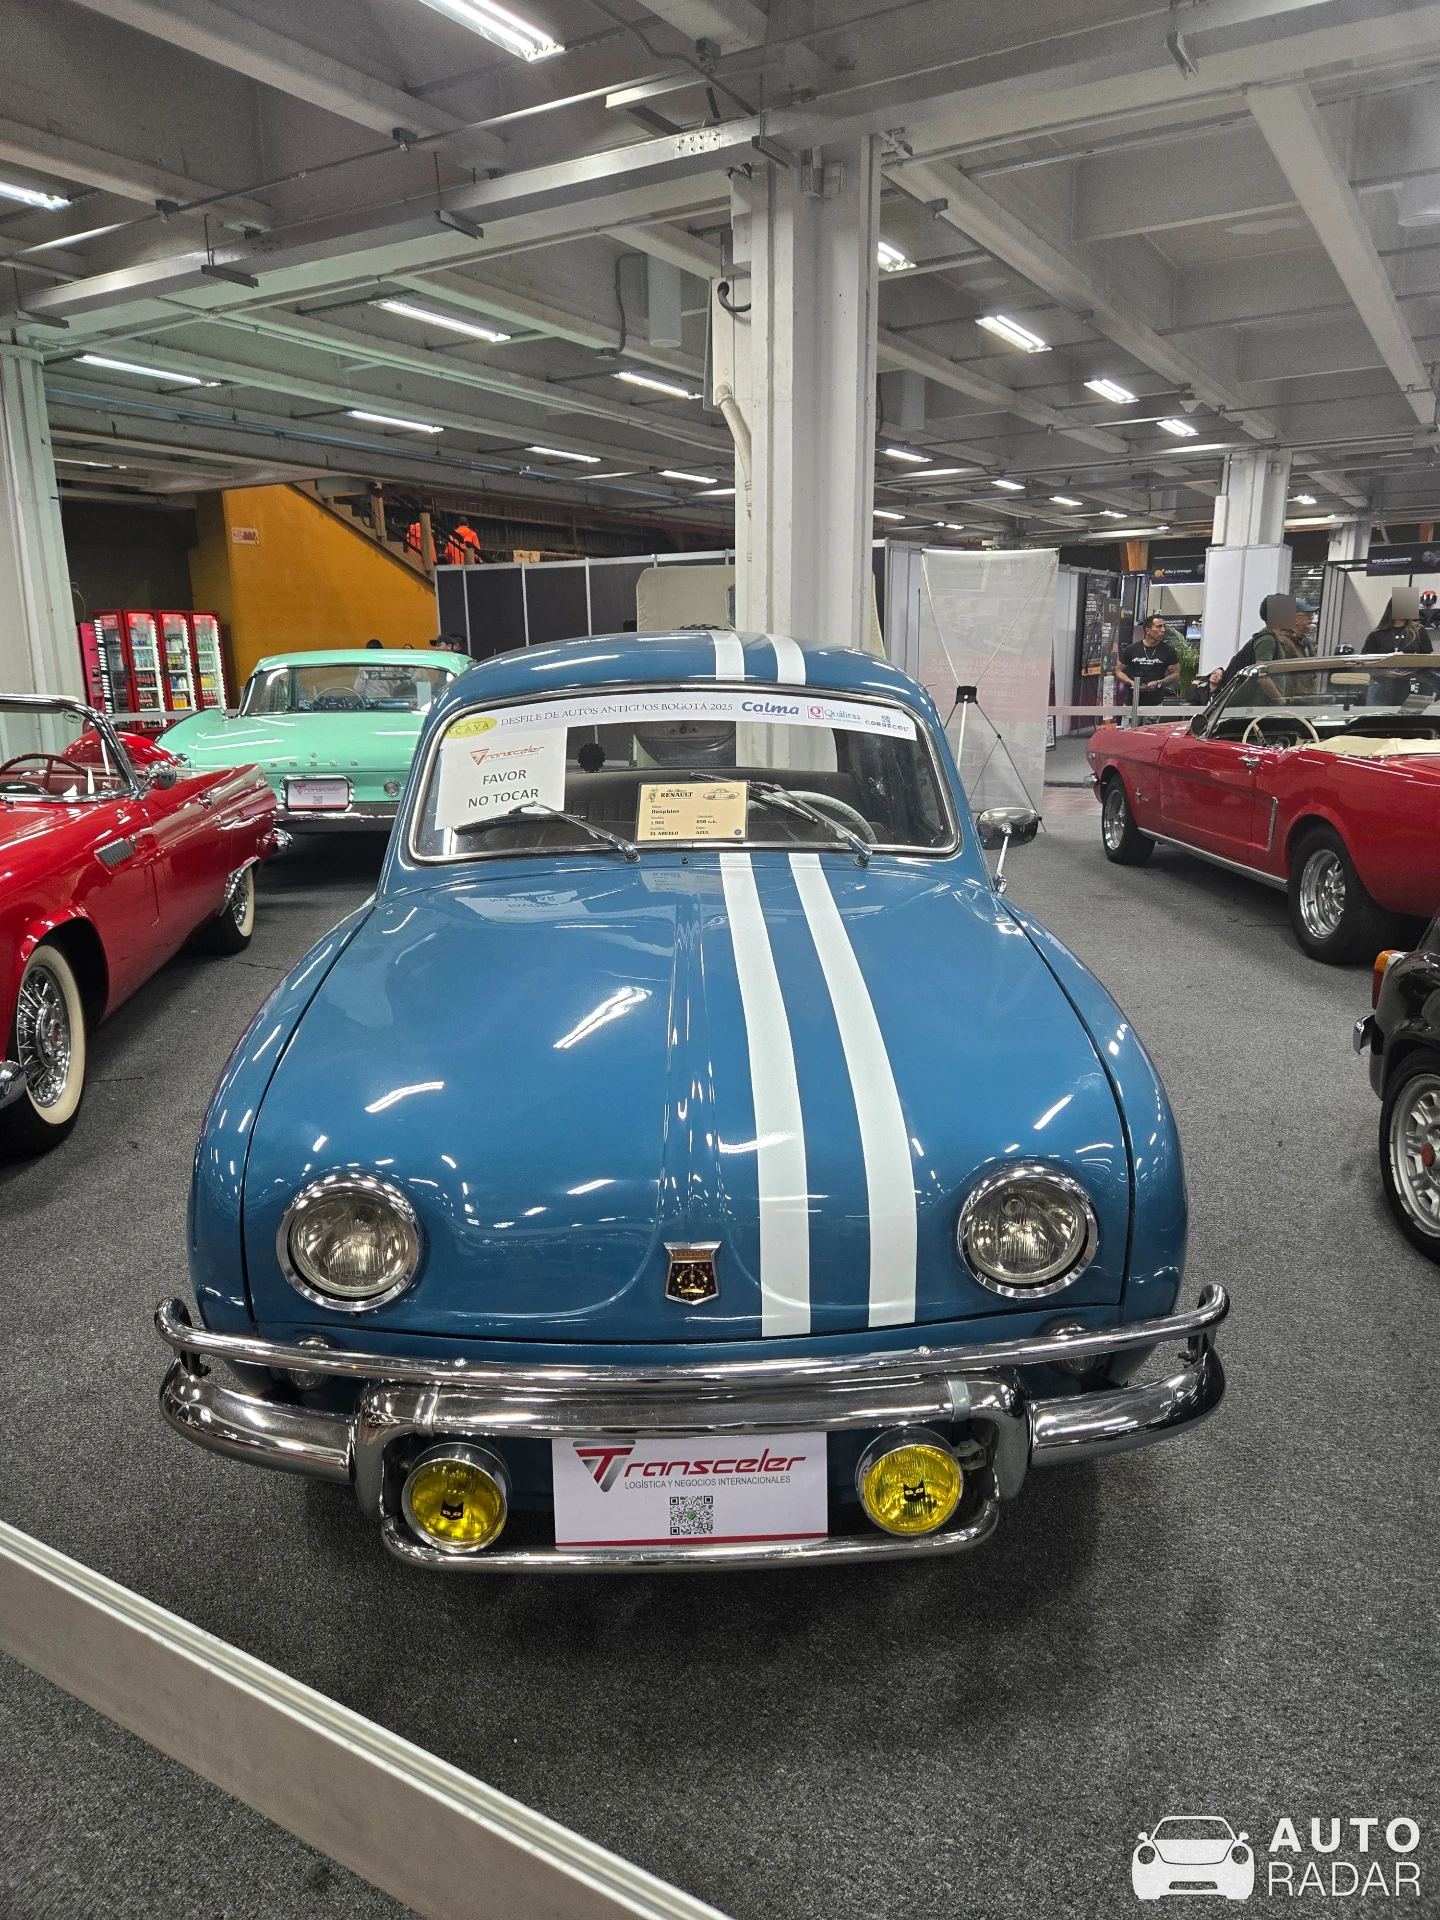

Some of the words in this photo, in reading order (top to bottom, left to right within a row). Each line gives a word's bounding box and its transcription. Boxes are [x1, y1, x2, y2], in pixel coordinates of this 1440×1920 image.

[501, 713, 542, 726] DESFILE
[545, 711, 559, 721] DE
[562, 707, 598, 718] AUTOS
[601, 703, 659, 715] ANTIGUOS
[661, 700, 708, 711] BOGOTÁ
[710, 702, 733, 711] 2025
[742, 701, 799, 716] Calma
[824, 709, 861, 720] Quálitas
[470, 745, 544, 766] Transceler
[482, 769, 527, 785] FAVOR
[468, 794, 489, 808] NO
[493, 788, 539, 804] TOCAR
[575, 1446, 806, 1485] Transceler
[624, 1479, 667, 1489] LOGÍSTICA
[667, 1479, 674, 1488] Y
[674, 1478, 717, 1487] NEGOCIOS
[718, 1475, 791, 1485] INTERNACIONALES
